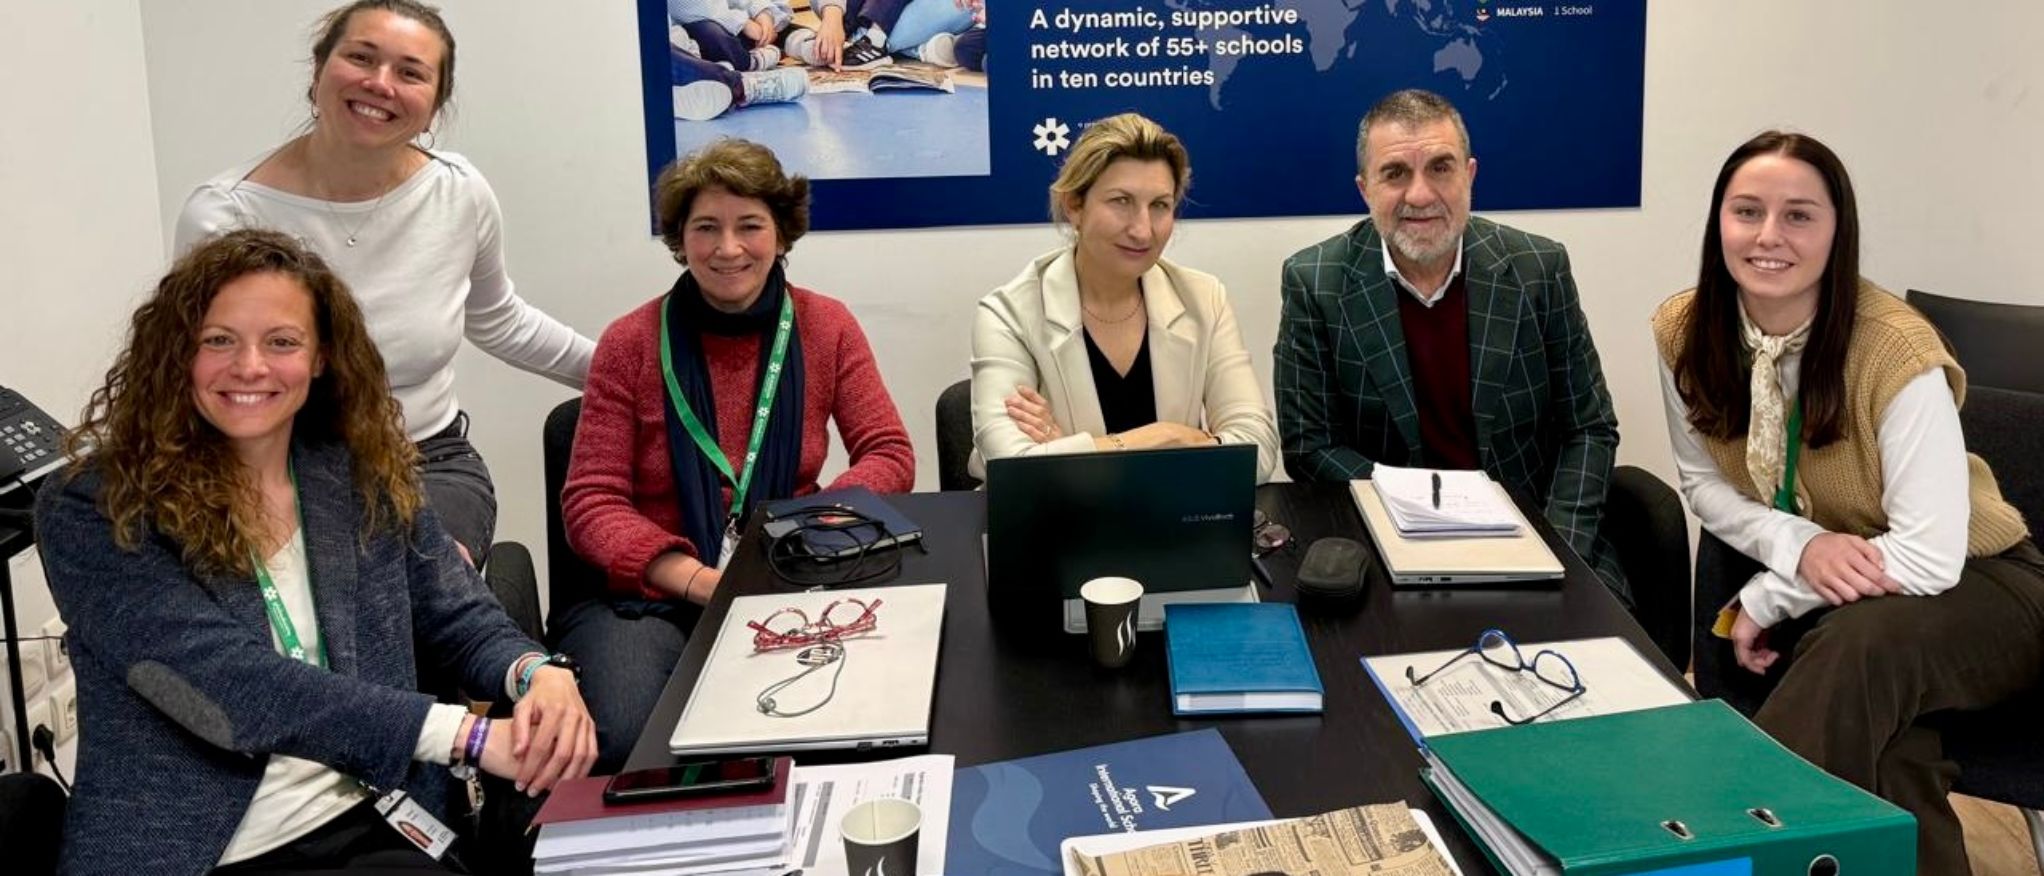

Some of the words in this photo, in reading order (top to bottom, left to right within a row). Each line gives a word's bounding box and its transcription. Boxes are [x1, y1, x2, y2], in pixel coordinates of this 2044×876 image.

[1030, 9, 1049, 29] A
[1055, 7, 1165, 32] dynamic,
[1171, 4, 1298, 31] supportive
[1496, 7, 1544, 17] MALAYSIA
[1561, 5, 1593, 16] School
[1031, 38, 1130, 59] network
[1136, 36, 1160, 57] of
[1166, 37, 1209, 57] 55+
[1215, 33, 1304, 55] schools
[1031, 68, 1053, 89] in
[1059, 70, 1098, 88] ten
[1104, 65, 1215, 87] countries
[1095, 763, 1131, 815] International
[1120, 814, 1138, 833] Scho
[1122, 787, 1143, 814] Agora
